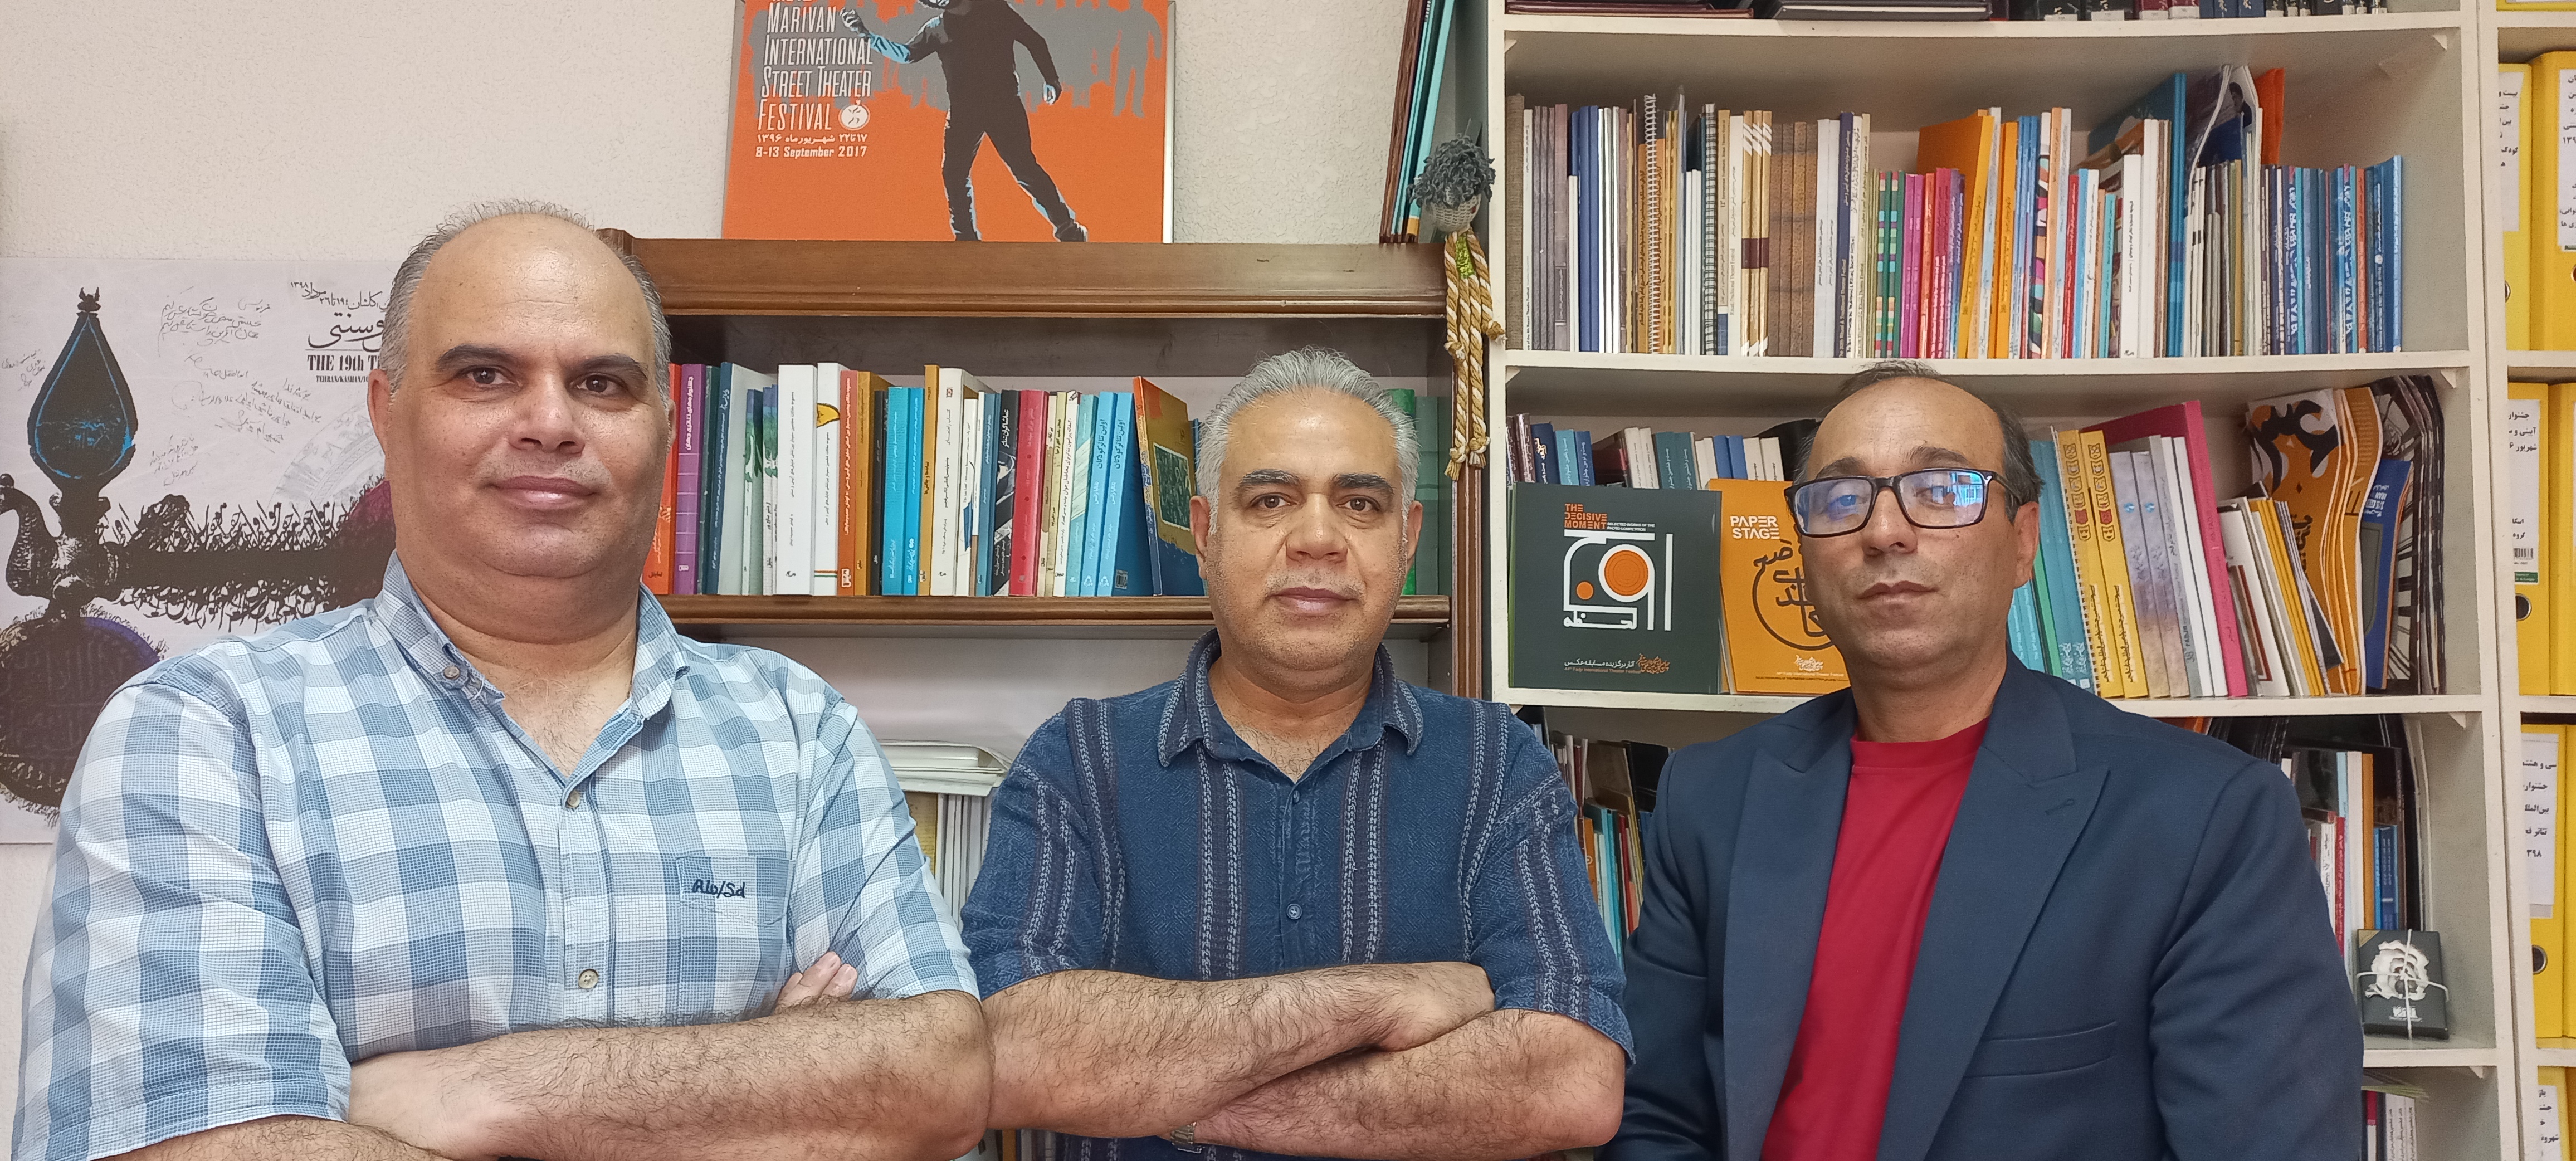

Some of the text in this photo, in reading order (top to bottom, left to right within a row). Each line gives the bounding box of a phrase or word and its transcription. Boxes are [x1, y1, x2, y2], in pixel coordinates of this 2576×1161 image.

[767, 2, 836, 33] MARIVAN
[763, 35, 873, 66] INTERNATIONAL
[761, 66, 872, 98] STREET THEATER
[758, 99, 832, 130] FESTIVAL
[755, 145, 867, 159] 8-13 September 2017
[307, 354, 335, 372] THE
[339, 354, 364, 372] 19th
[2508, 411, 2530, 421] جشنوار
[1098, 419, 1108, 436] اولین
[1116, 419, 1125, 436] اولین
[1096, 446, 1106, 469] کودکان
[1113, 446, 1123, 469] کودکان
[1564, 503, 1583, 512] THE
[1564, 512, 1607, 521] DECISIVE
[1564, 520, 1607, 530] MOMENT
[1730, 515, 1779, 528] PAPER
[1732, 527, 1780, 540] STAGE
[2526, 848, 2543, 857] ۳۹۸
